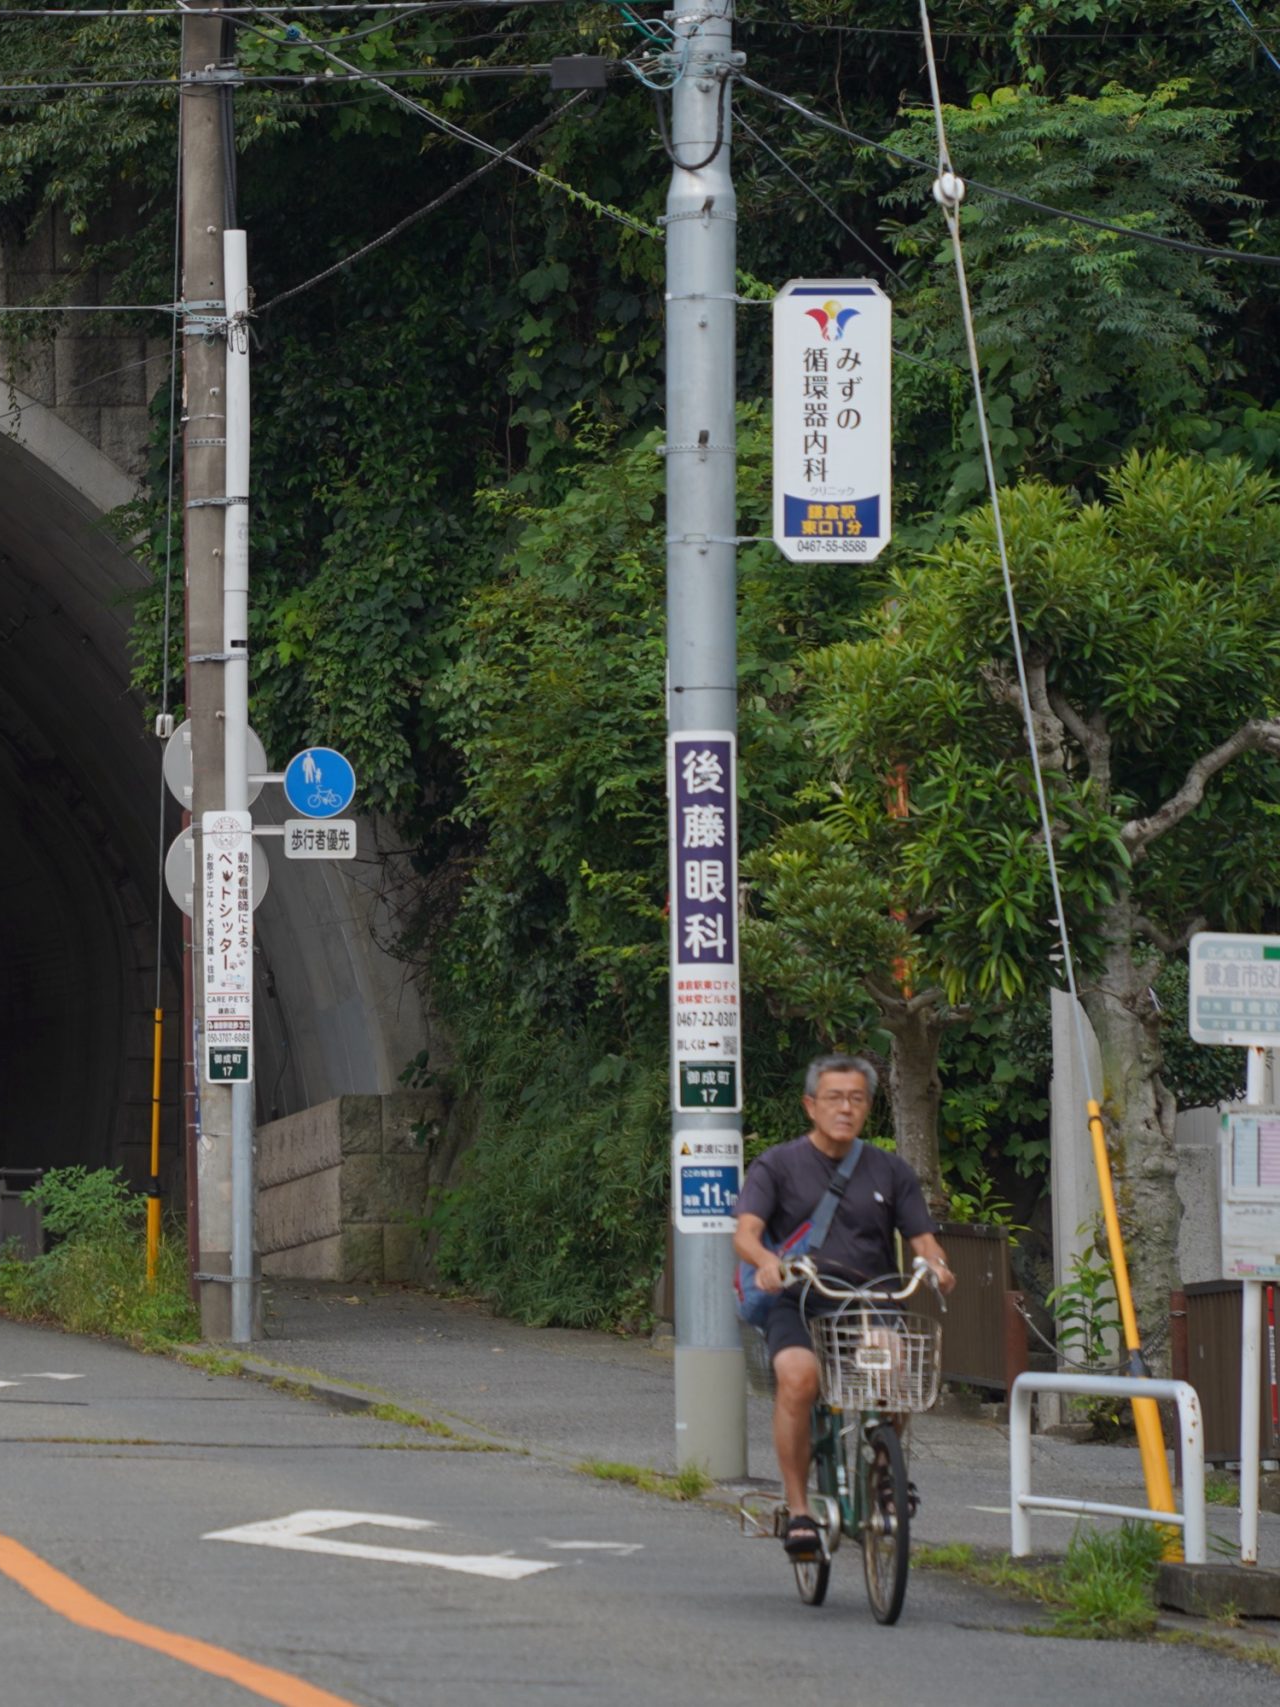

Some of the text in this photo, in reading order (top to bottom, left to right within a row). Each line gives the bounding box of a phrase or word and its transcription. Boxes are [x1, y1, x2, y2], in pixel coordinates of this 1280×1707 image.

[836, 347, 863, 430] みずの
[803, 347, 829, 483] 循環器内科
[809, 486, 855, 496] クリニック
[801, 520, 862, 535] 東口1分
[797, 540, 867, 552] 0467-55-8588
[291, 828, 351, 852] 歩行者優先
[681, 749, 728, 959] 後藤眼科
[1204, 962, 1280, 988] 鎌倉市役
[207, 995, 250, 1003] CARE PETS
[222, 1066, 233, 1077] 17
[686, 1070, 730, 1085] 御成町
[700, 1088, 718, 1103] 17
